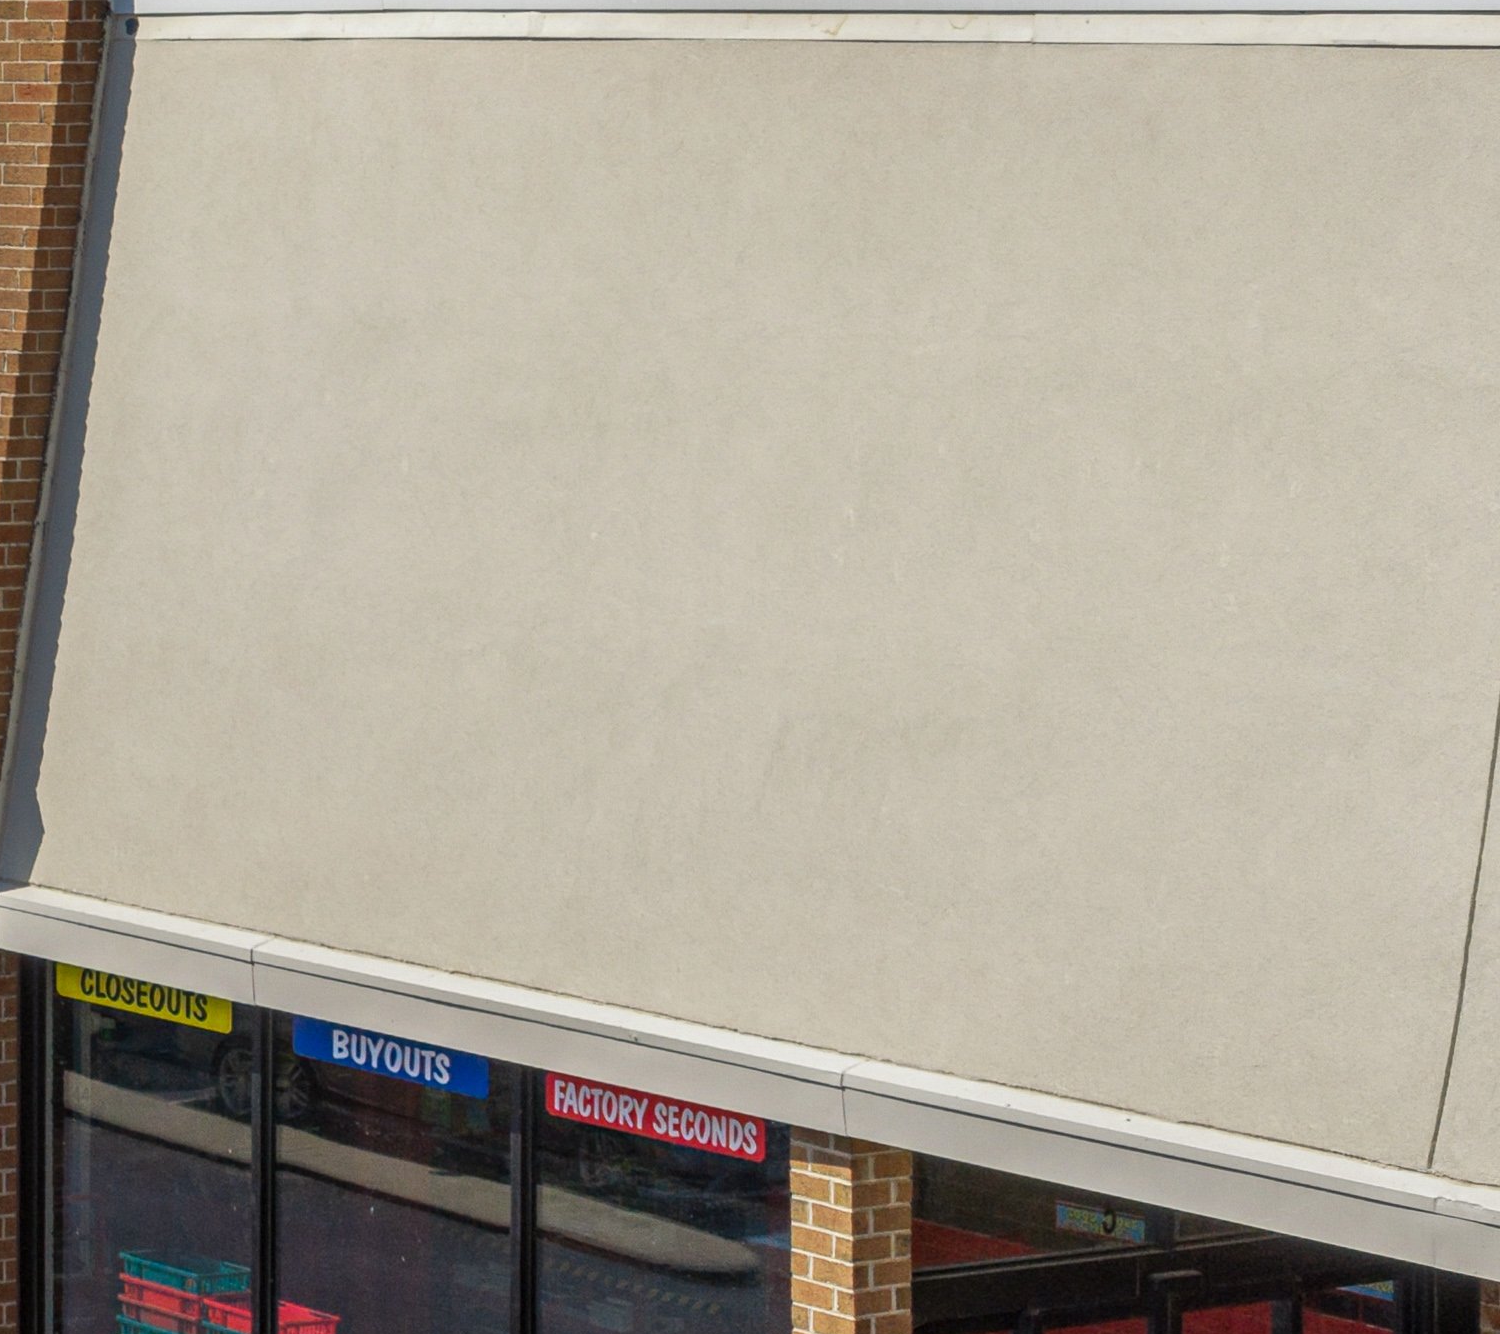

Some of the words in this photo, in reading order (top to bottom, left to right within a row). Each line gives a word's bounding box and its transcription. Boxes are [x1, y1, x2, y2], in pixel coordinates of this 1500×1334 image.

[79, 968, 208, 1023] CLOSEOUTS
[331, 1028, 452, 1086] BUYOUTS
[552, 1078, 648, 1132] FACTORY
[652, 1097, 760, 1156] SECONDS
